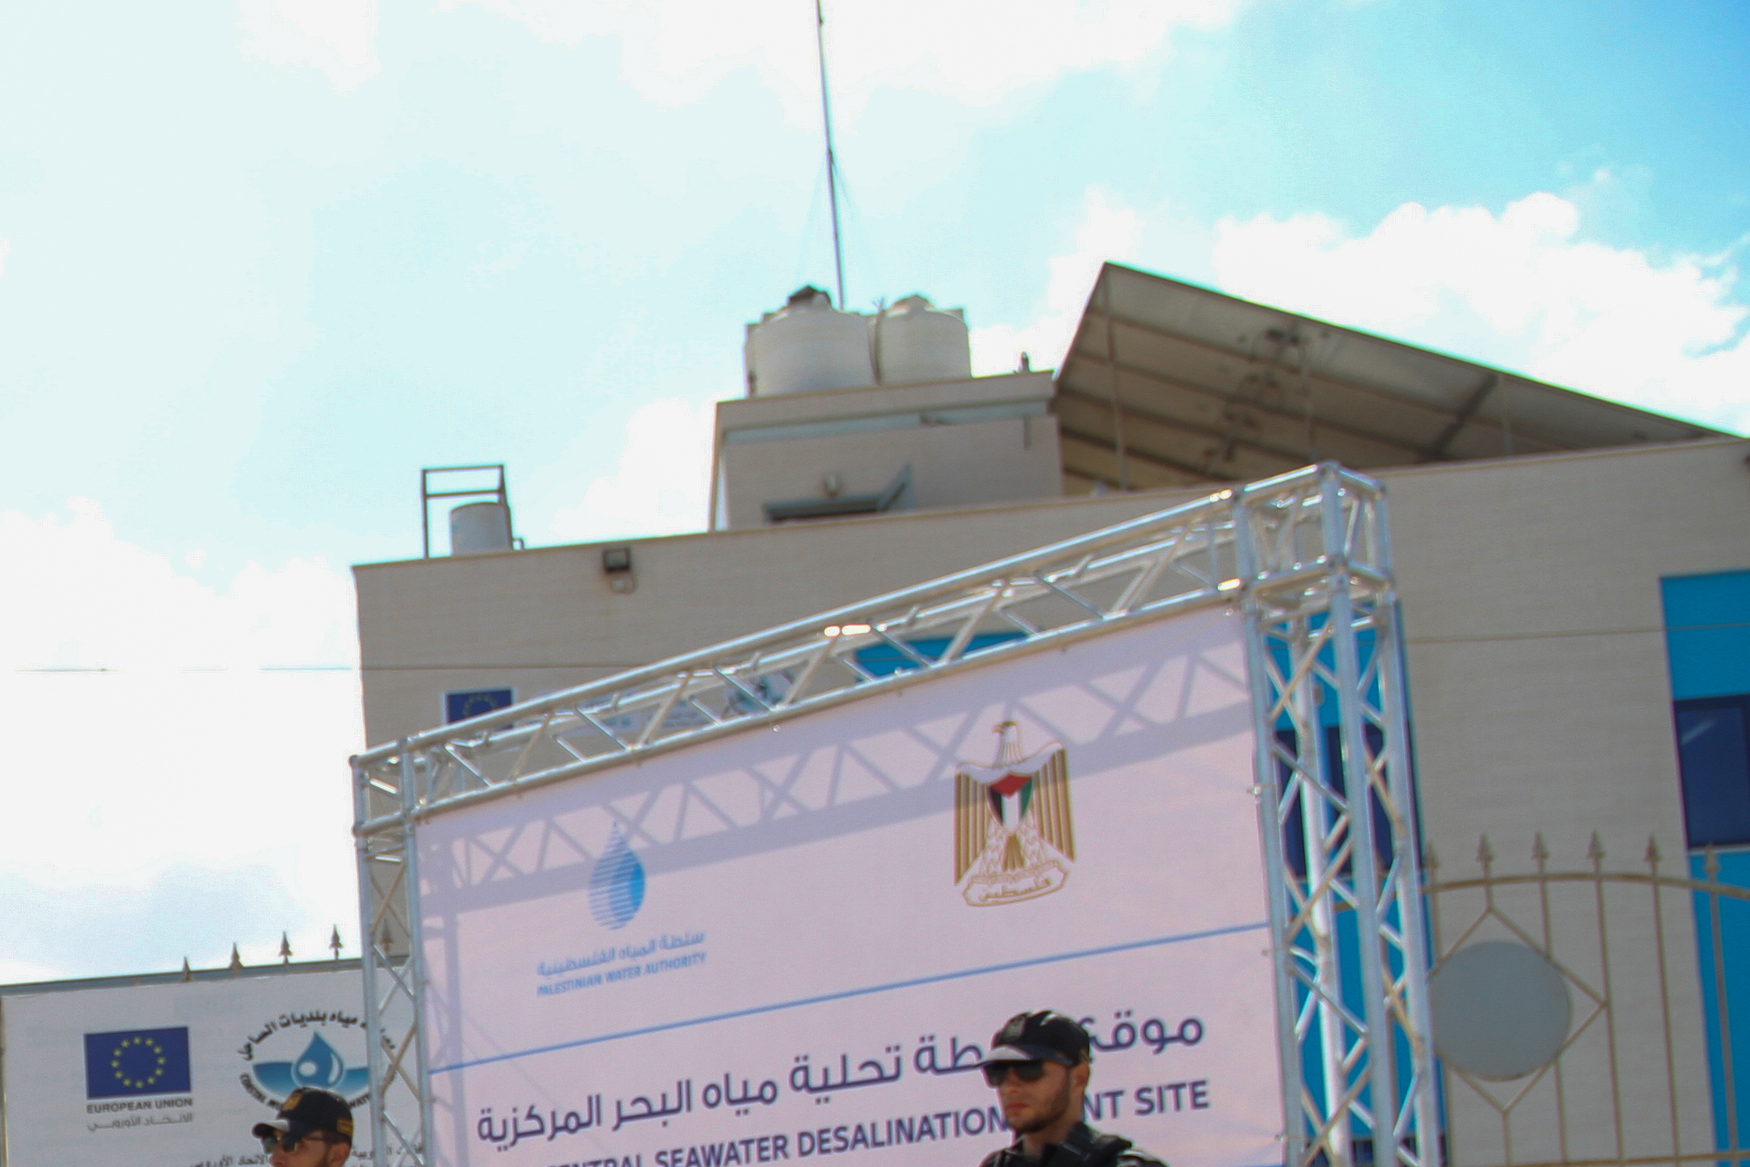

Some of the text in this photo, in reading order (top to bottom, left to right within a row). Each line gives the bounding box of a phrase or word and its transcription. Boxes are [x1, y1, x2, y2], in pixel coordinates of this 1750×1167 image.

[537, 931, 706, 979] سلطة المياه الفلسطينية
[537, 952, 707, 997] PALESTINIAN WATER AUTHORITY
[789, 1044, 902, 1104] تحلية
[913, 1035, 990, 1076] طة
[87, 1098, 193, 1114] EUROPEAN UNION
[611, 1079, 692, 1131] البحر
[702, 1072, 778, 1116] مياه
[477, 1094, 602, 1152] المركزية
[796, 1105, 1008, 1158] DESALINATION
[1134, 1080, 1210, 1116] SITE
